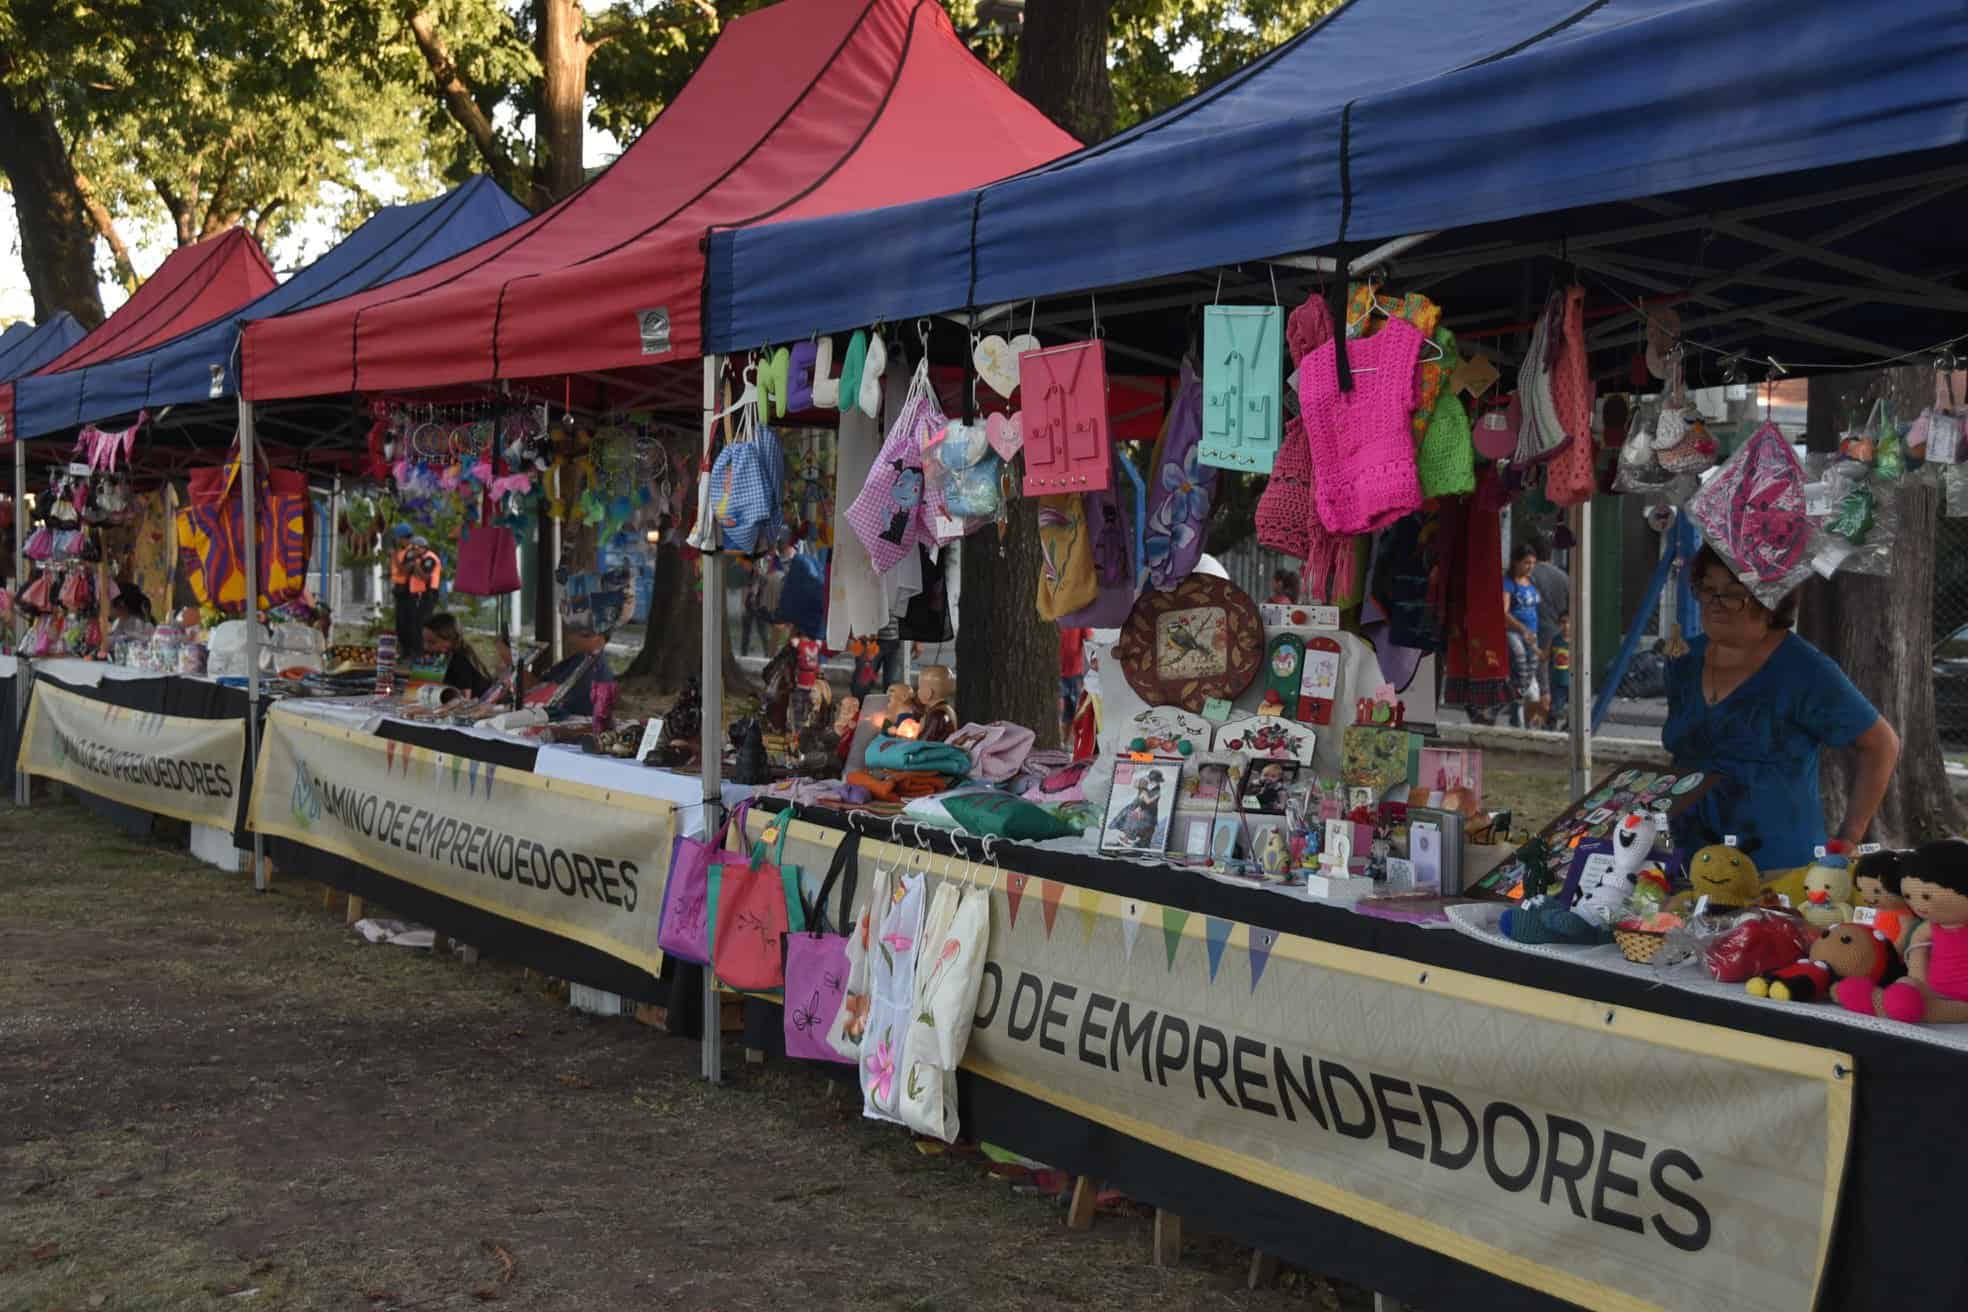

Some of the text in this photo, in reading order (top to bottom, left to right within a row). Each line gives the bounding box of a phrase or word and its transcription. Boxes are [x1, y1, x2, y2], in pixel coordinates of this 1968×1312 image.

[378, 800, 412, 848] DE
[406, 809, 639, 913] EMPRENDEDORES
[1007, 971, 1078, 1056] DE
[1078, 992, 1712, 1252] EMPRENDEDORES
